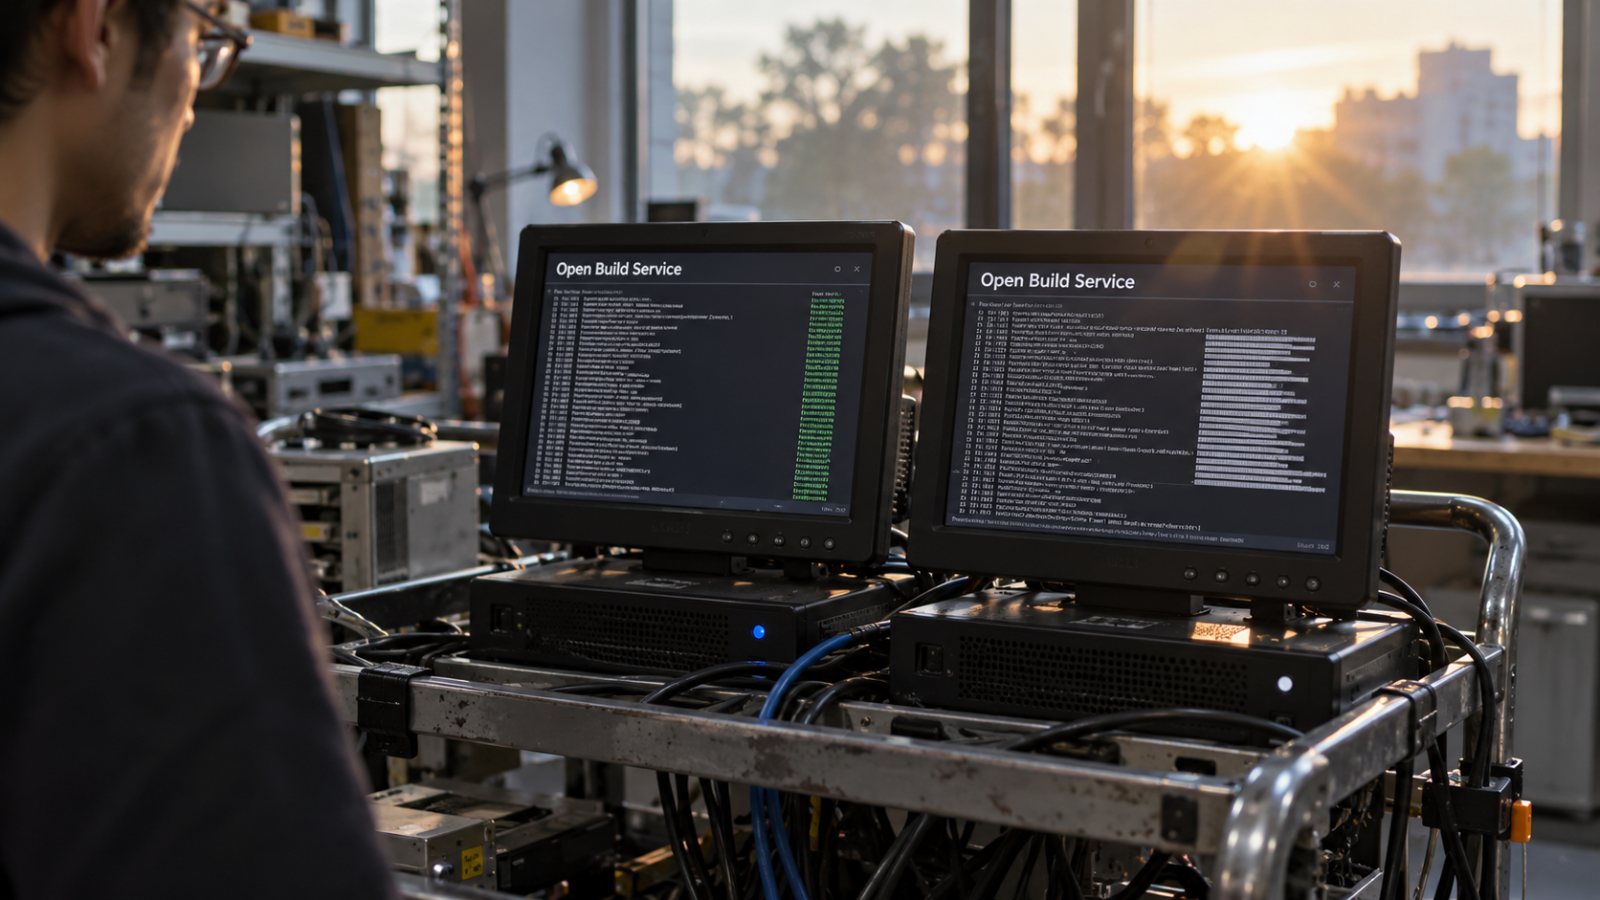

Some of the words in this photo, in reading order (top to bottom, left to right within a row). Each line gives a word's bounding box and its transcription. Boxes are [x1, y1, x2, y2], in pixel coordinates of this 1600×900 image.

[556, 261, 592, 279] Open
[595, 261, 629, 276] Build
[632, 261, 683, 277] Service
[980, 271, 1024, 291] Open
[1029, 272, 1071, 289] Build
[1074, 273, 1136, 290] Service
